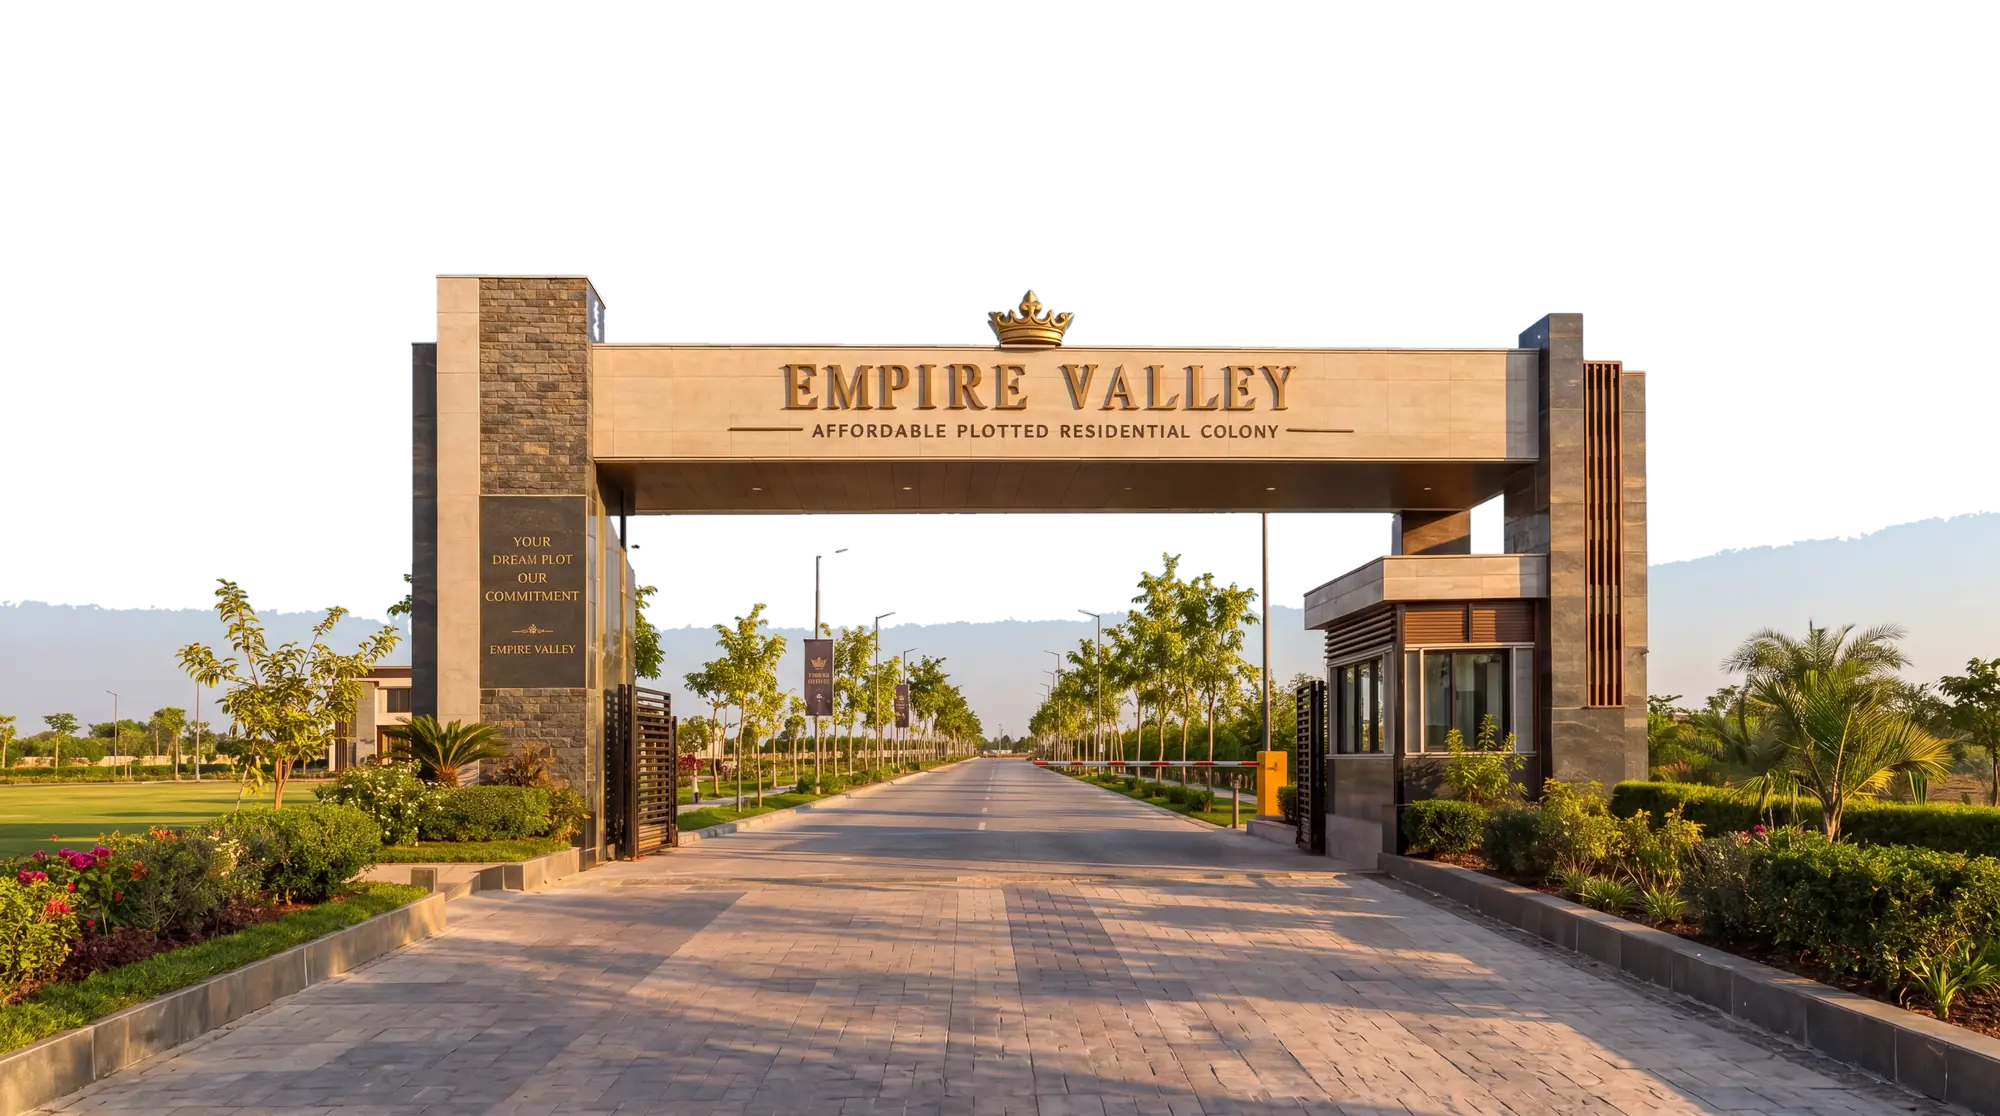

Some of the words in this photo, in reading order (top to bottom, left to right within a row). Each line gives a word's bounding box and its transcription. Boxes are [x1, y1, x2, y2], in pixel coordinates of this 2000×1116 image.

[782, 363, 1028, 411] EMPIRE
[1058, 363, 1297, 411] VALLEY
[811, 423, 947, 438] AFFORDABLE
[957, 424, 1049, 438] PLOTTED
[1060, 424, 1190, 439] RESIDENTIAL
[1200, 424, 1279, 439] COLONY
[513, 536, 552, 547] YOUR
[492, 554, 537, 565] DREAM
[541, 554, 573, 565] PLOT
[517, 572, 548, 583] OUR
[485, 591, 580, 602] COMMITMENT
[490, 645, 531, 655] EMPIRE
[534, 644, 576, 654] VALLEY
